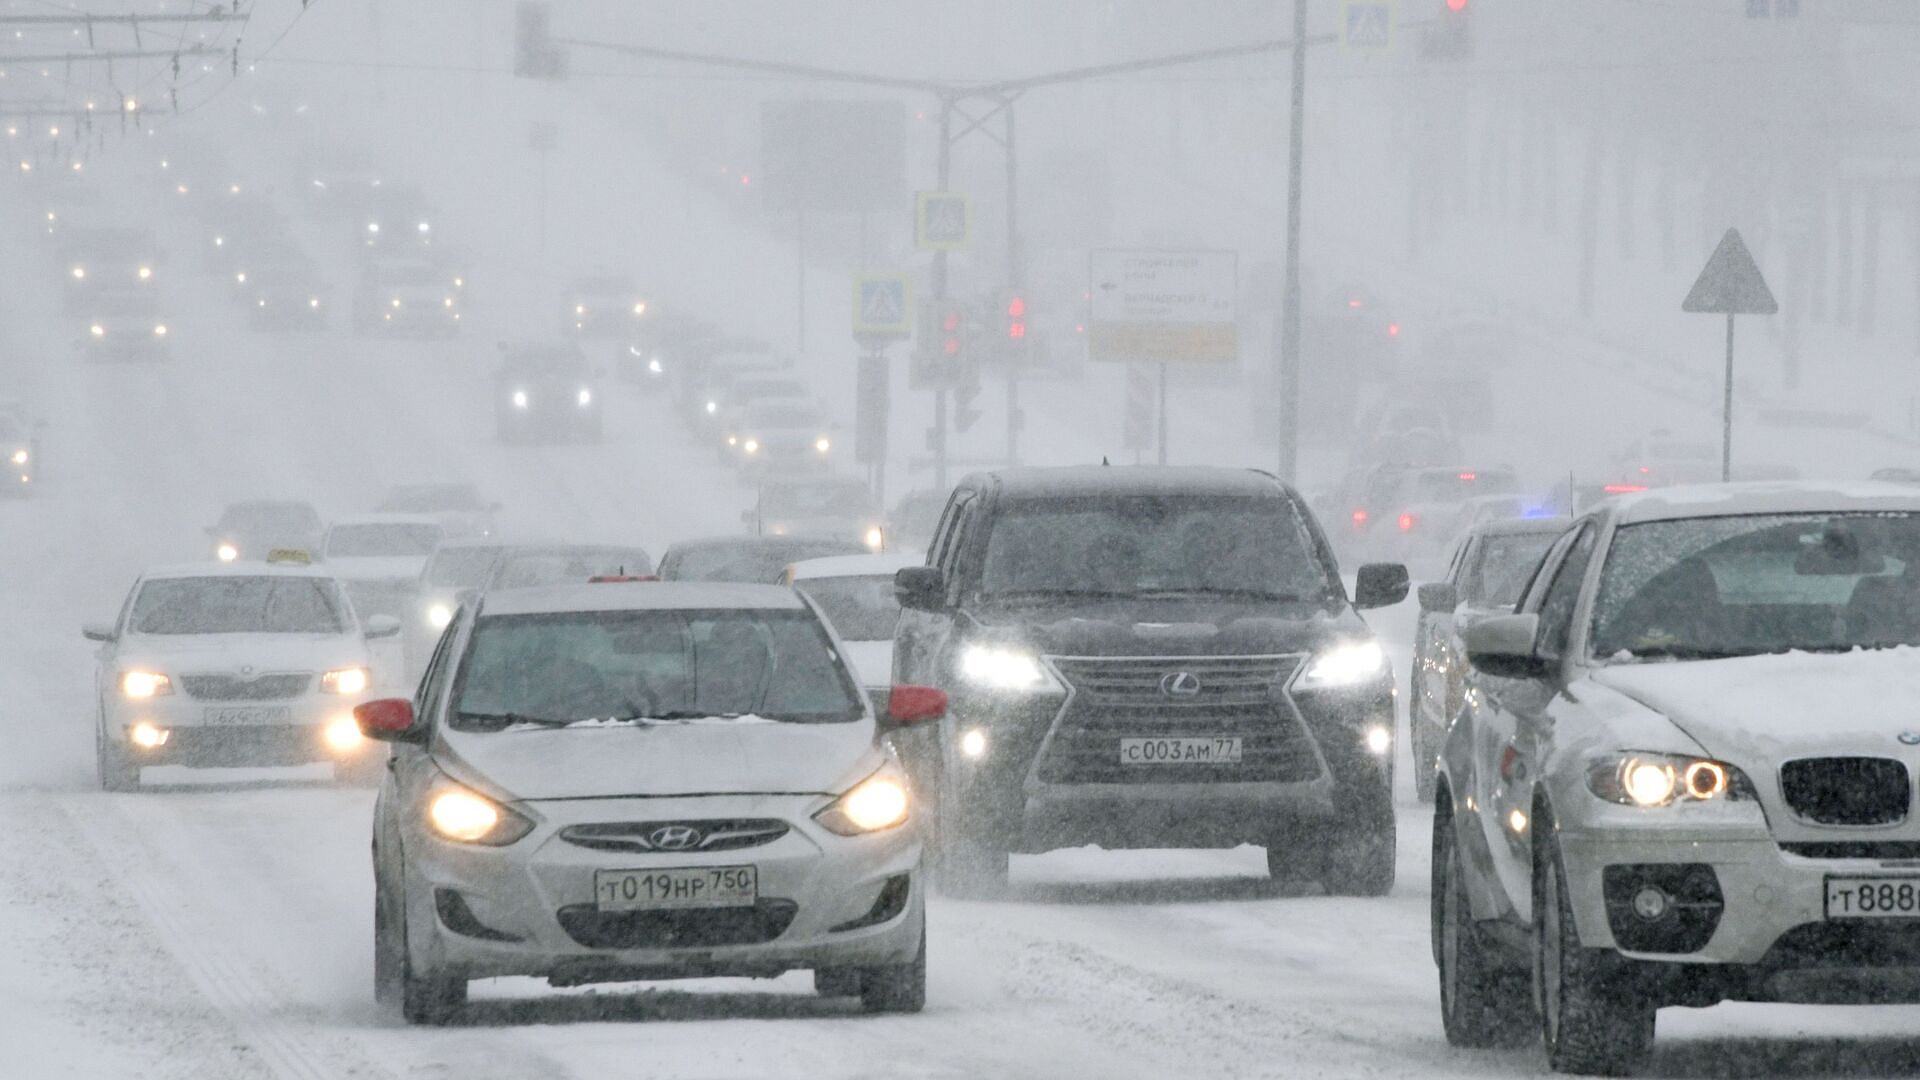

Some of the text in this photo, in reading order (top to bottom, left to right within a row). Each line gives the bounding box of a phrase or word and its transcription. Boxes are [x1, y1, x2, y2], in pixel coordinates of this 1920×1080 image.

[1128, 739, 1234, 760] С003АМ 77
[606, 869, 750, 901] Т019НР 750
[1838, 883, 1920, 912] Т888
